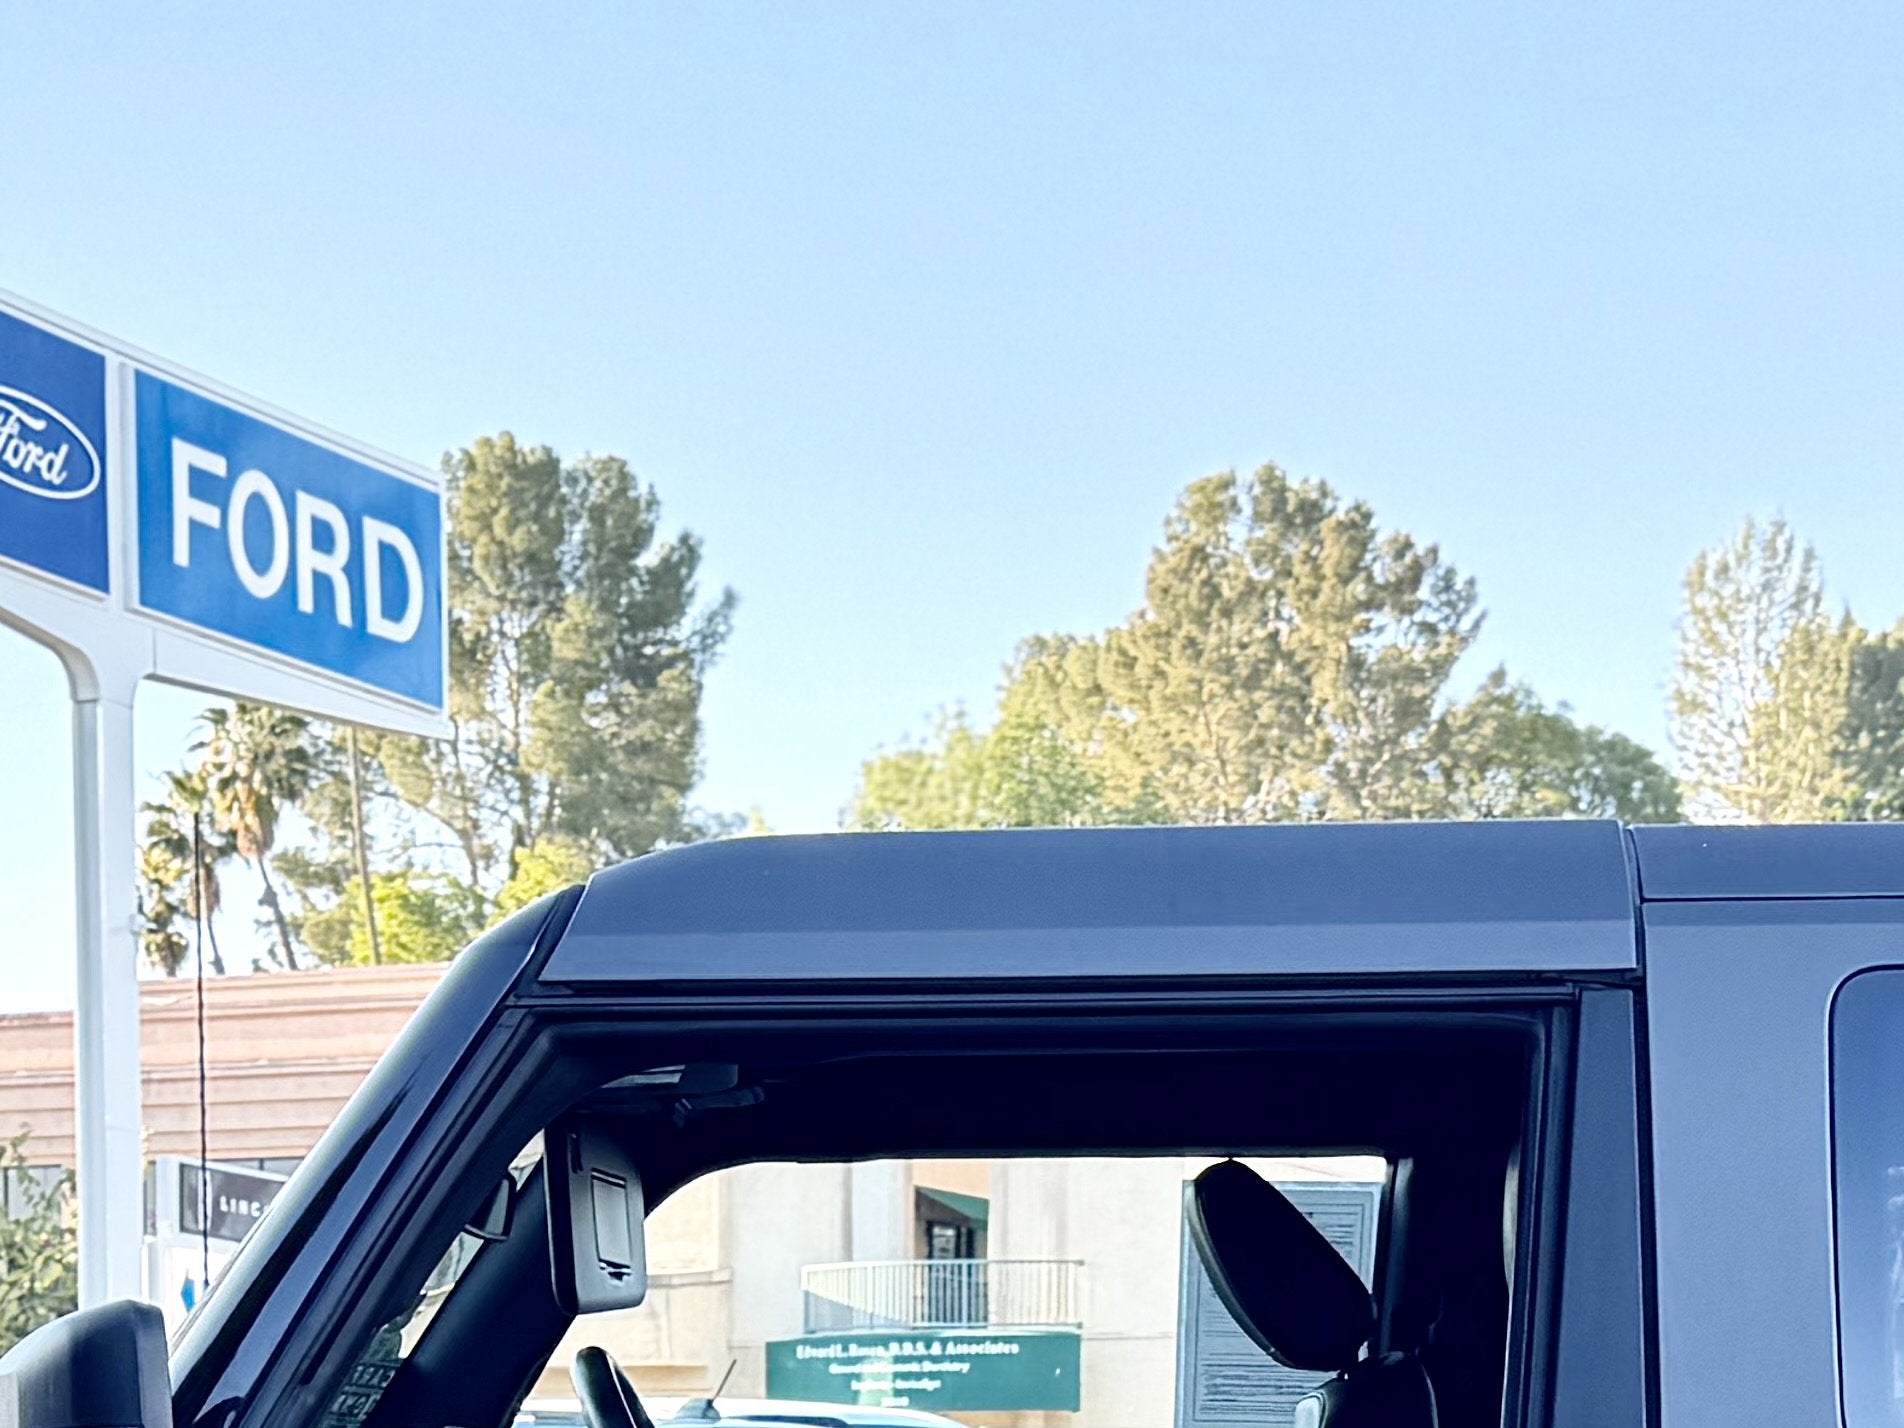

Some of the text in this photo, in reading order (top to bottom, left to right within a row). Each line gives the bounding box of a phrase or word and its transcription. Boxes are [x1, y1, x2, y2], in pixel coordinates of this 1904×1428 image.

[171, 437, 424, 644] FORD
[219, 1195, 270, 1218] LINC
[945, 1340, 1019, 1356] Associates
